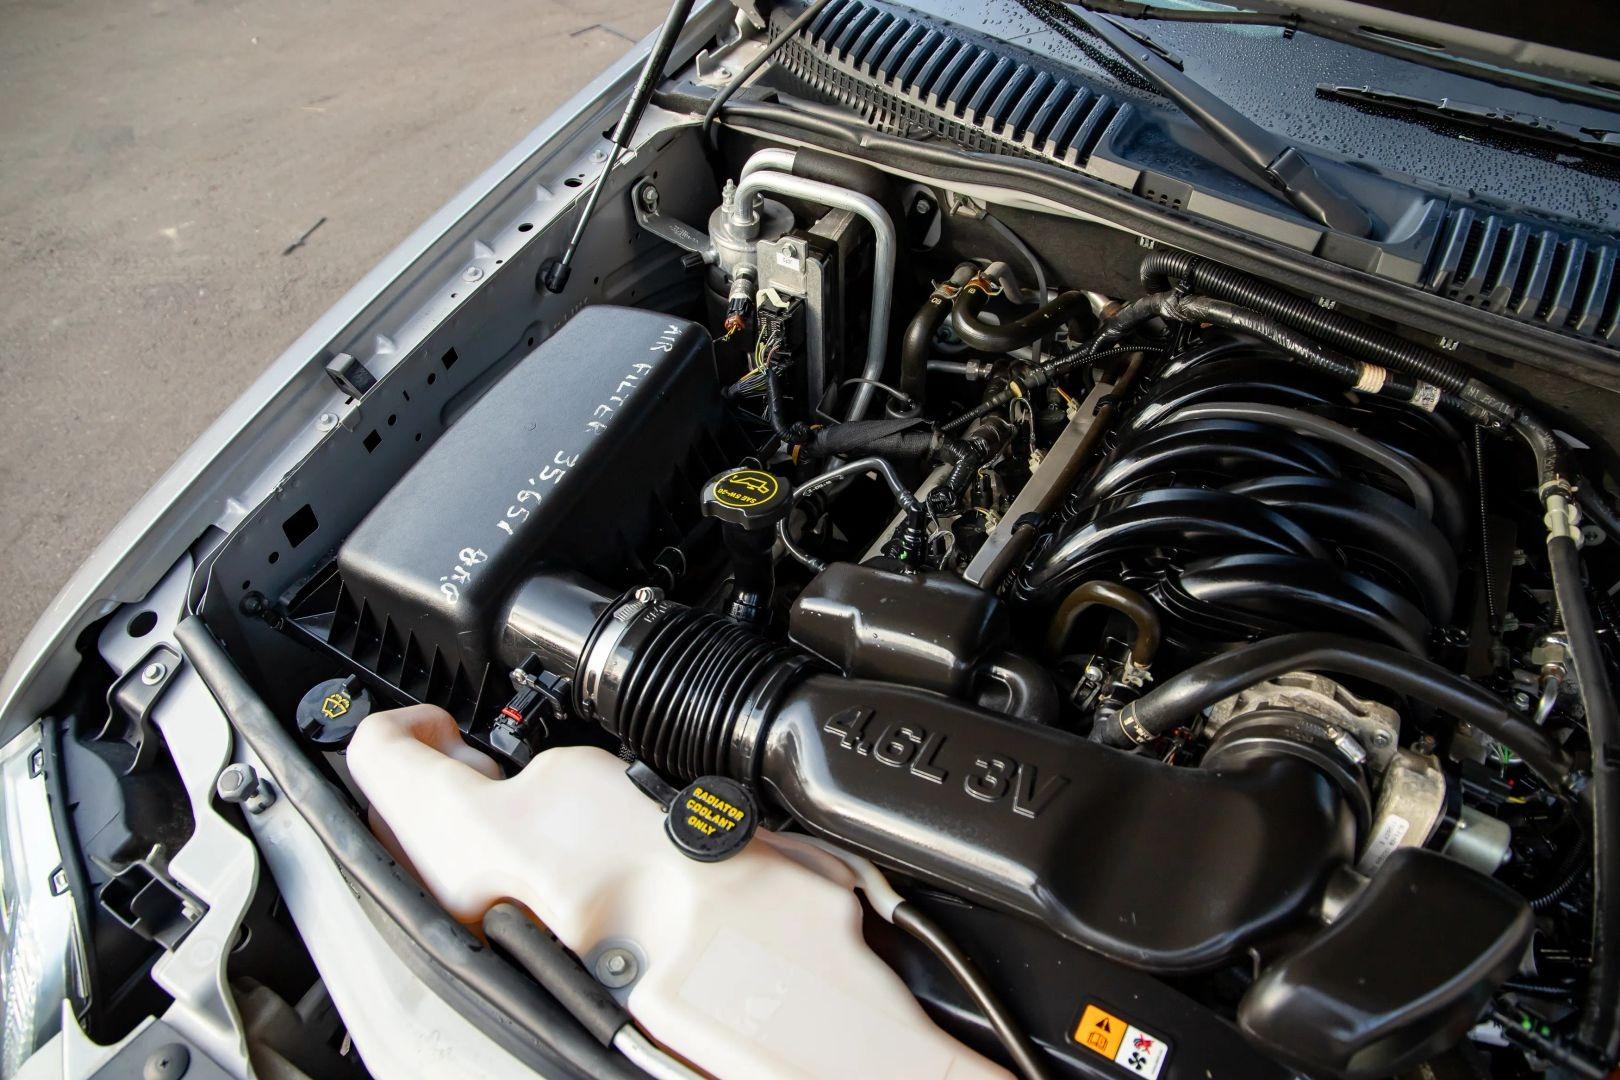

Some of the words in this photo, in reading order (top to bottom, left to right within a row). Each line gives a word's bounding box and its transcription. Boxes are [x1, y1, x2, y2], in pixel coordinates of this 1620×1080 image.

[649, 323, 684, 354] AIR
[585, 362, 652, 437] FILTER
[740, 495, 757, 504] SAE
[823, 703, 950, 786] 4.6L
[963, 752, 1072, 820] 3V
[686, 799, 736, 831] COOLANT
[692, 787, 745, 822] RADIATOR
[687, 815, 717, 836] ONLY
